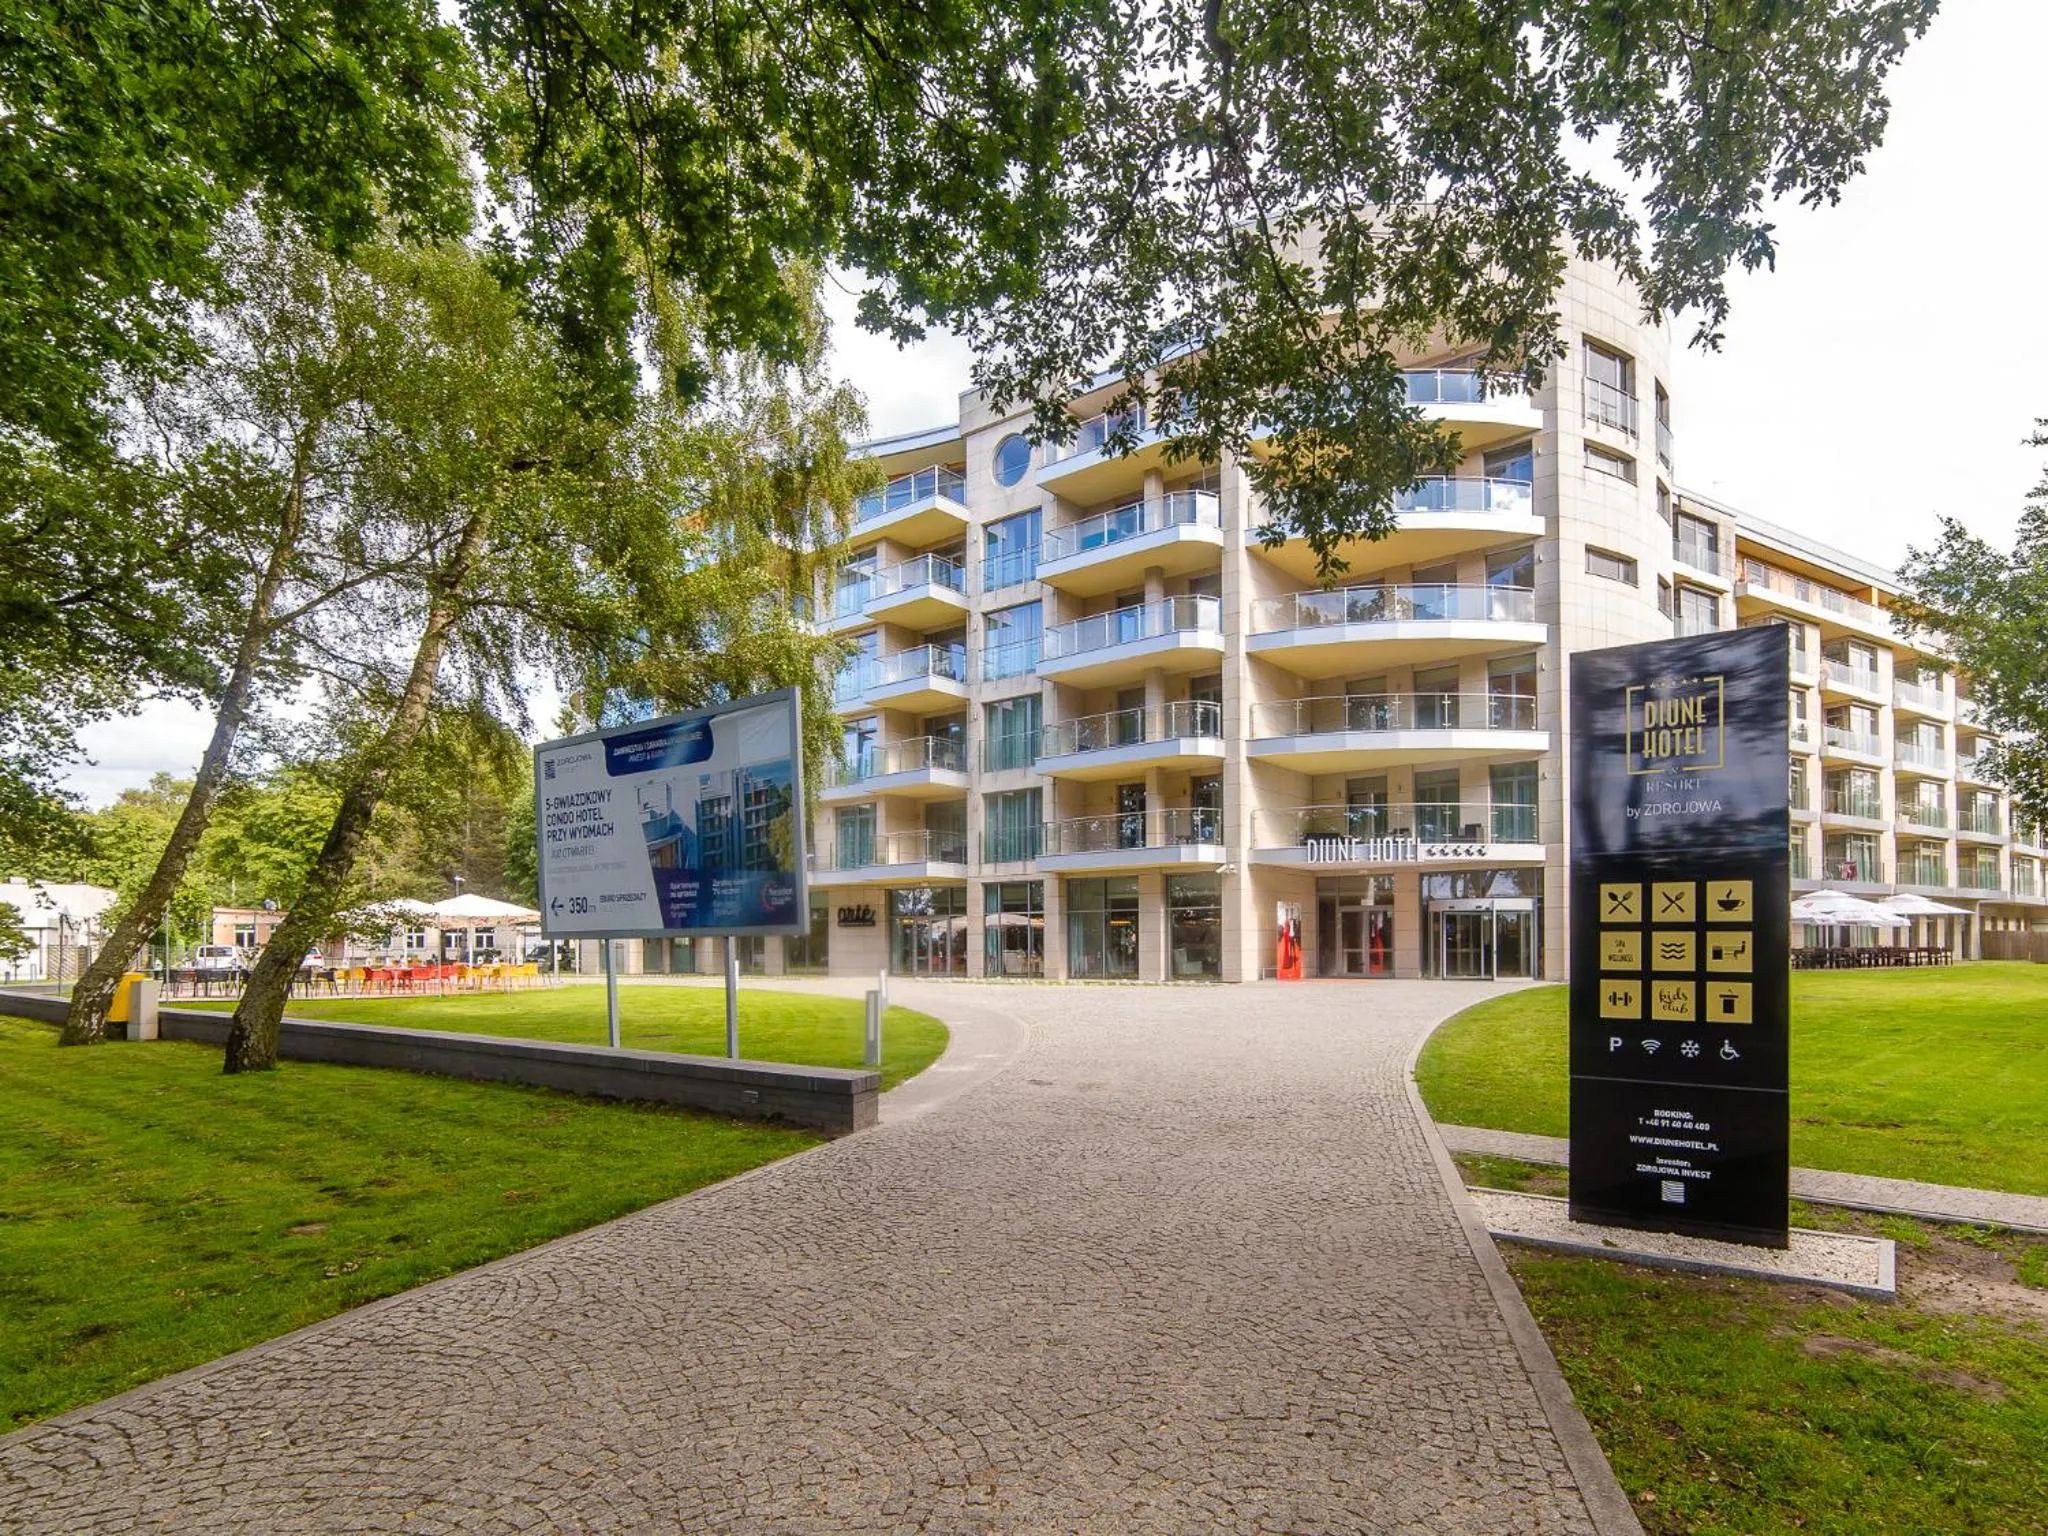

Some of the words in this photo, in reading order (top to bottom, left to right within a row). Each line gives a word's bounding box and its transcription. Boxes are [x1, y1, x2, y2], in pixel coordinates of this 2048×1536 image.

[1644, 695, 1707, 728] DIUNE
[1642, 726, 1706, 758] HOTEL
[1646, 778, 1703, 792] RESORT
[545, 789, 612, 810] 5-GWIAZDKOWY
[546, 811, 574, 826] CONDO
[576, 807, 603, 823] HOTEL
[1626, 806, 1640, 818] by
[1643, 800, 1722, 816] ZDROJOWA
[547, 828, 568, 842] PRZY
[569, 823, 614, 840] WYDMACH
[1307, 838, 1360, 864] DIUNE
[1369, 837, 1424, 863] HOTEL
[568, 897, 588, 914] 350
[1662, 1001, 1688, 1014] club
[1661, 1119, 1670, 1127] 91
[1629, 1135, 1720, 1151] WWW.DIUNEHOTEL.PL
[1636, 1163, 1680, 1177] ZDROJOWA
[1681, 1168, 1712, 1180] INVEST
